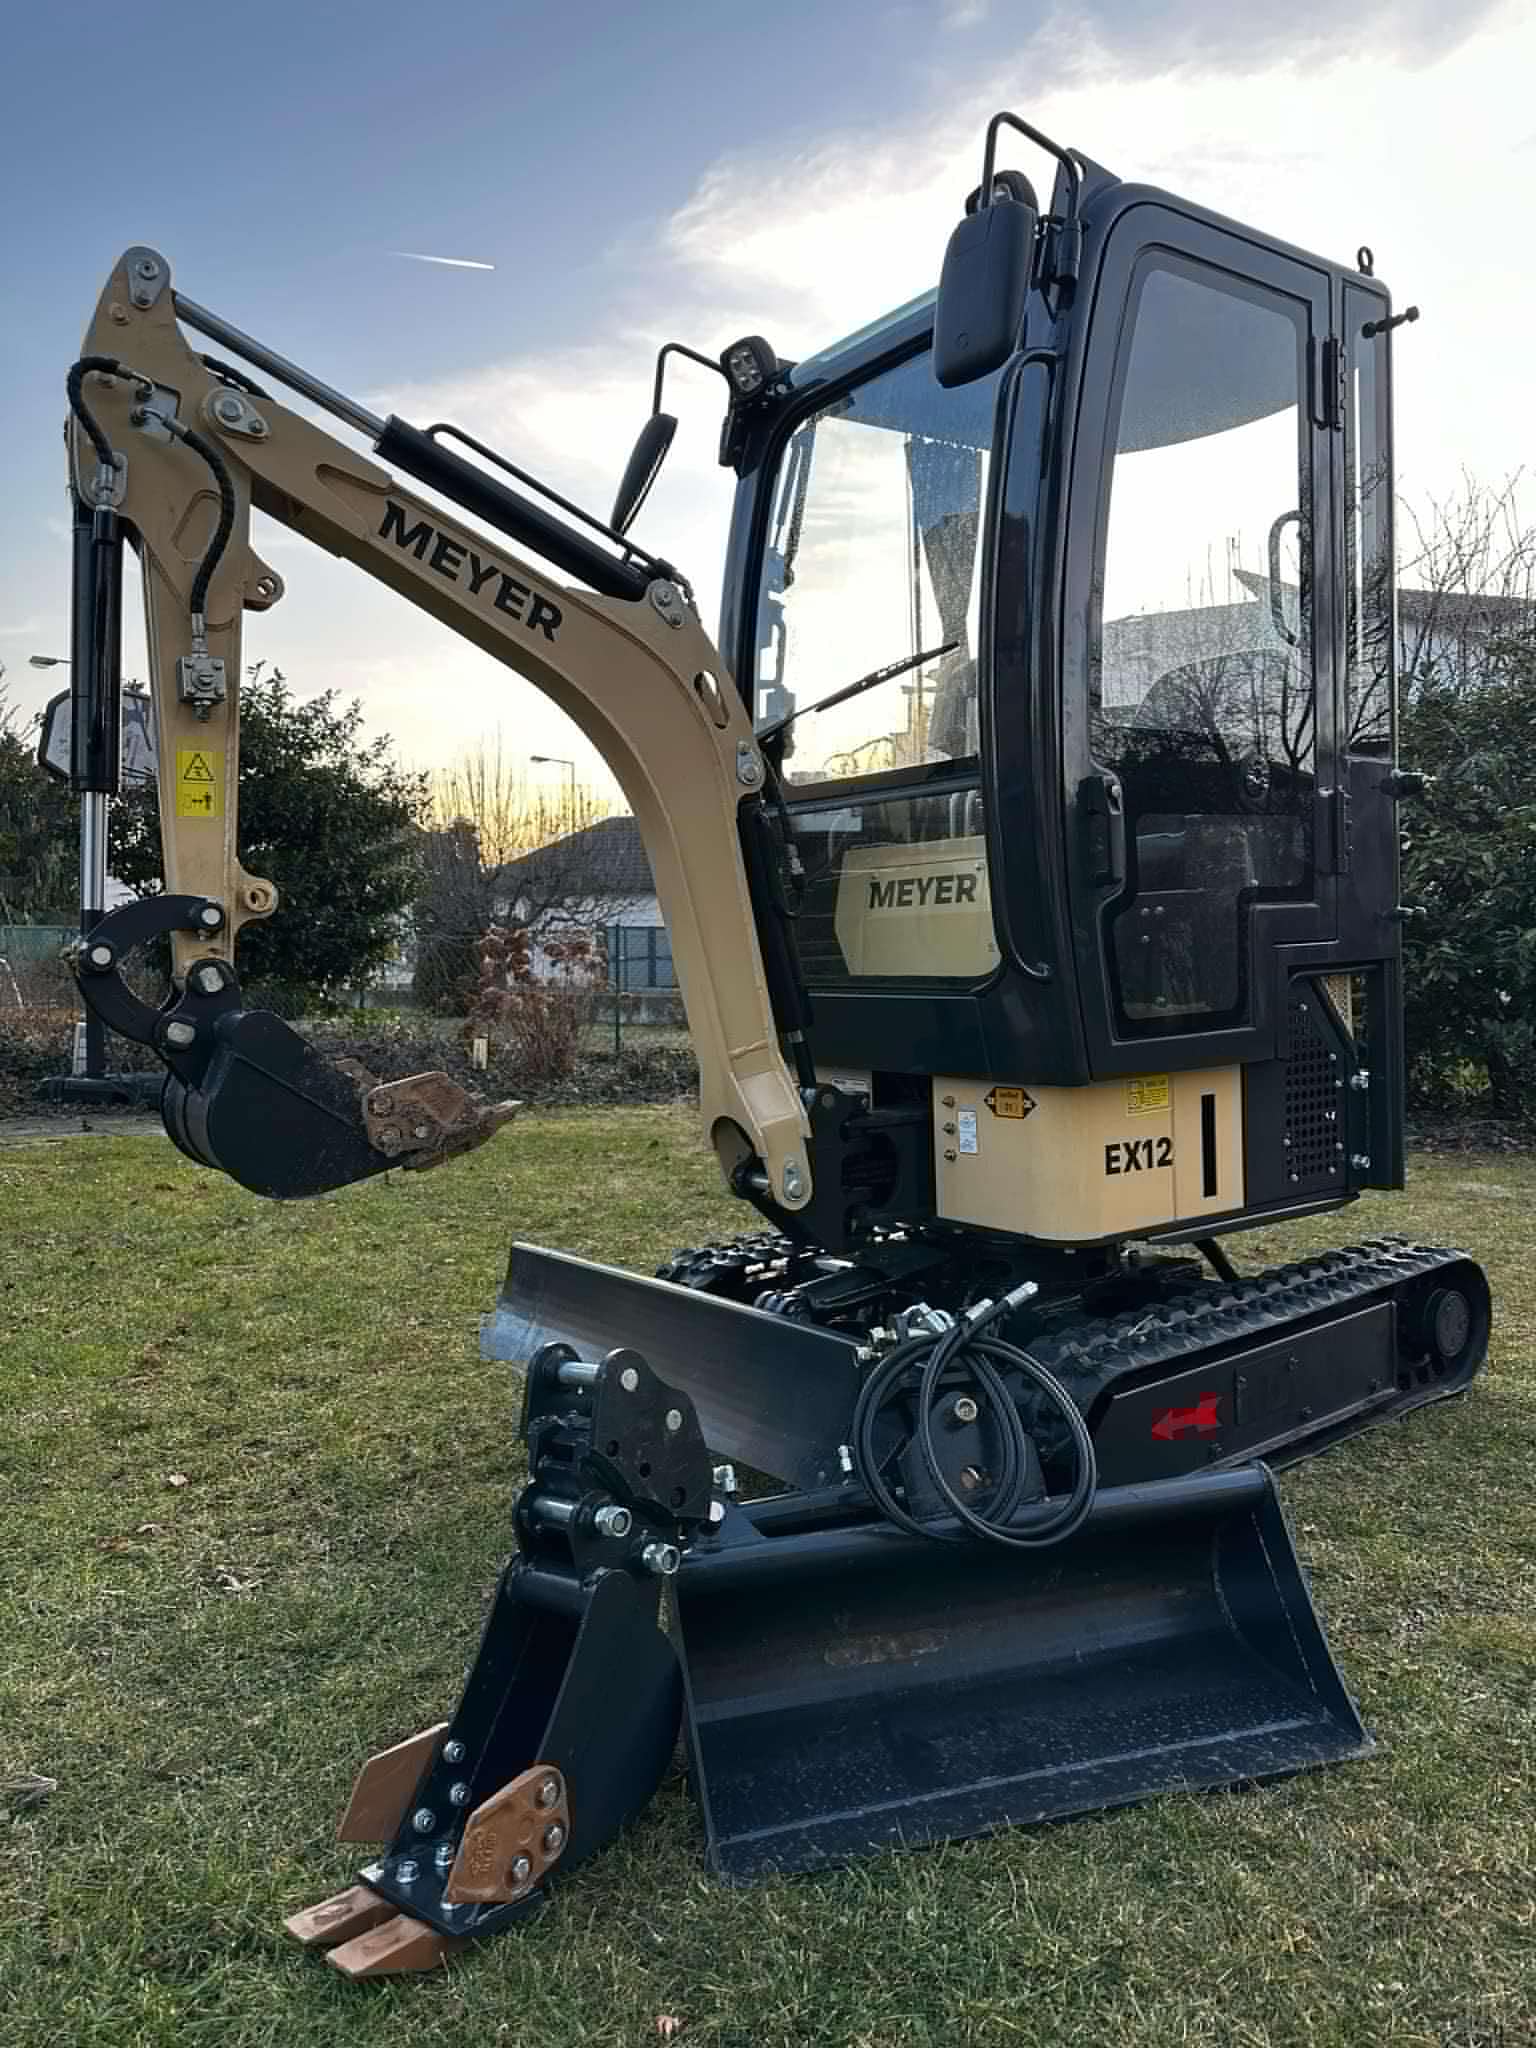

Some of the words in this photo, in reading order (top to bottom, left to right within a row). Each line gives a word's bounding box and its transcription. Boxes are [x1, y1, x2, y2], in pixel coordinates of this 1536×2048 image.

[378, 500, 562, 642] MEYER
[869, 873, 977, 910] MEYER
[1105, 1137, 1173, 1176] EX12
